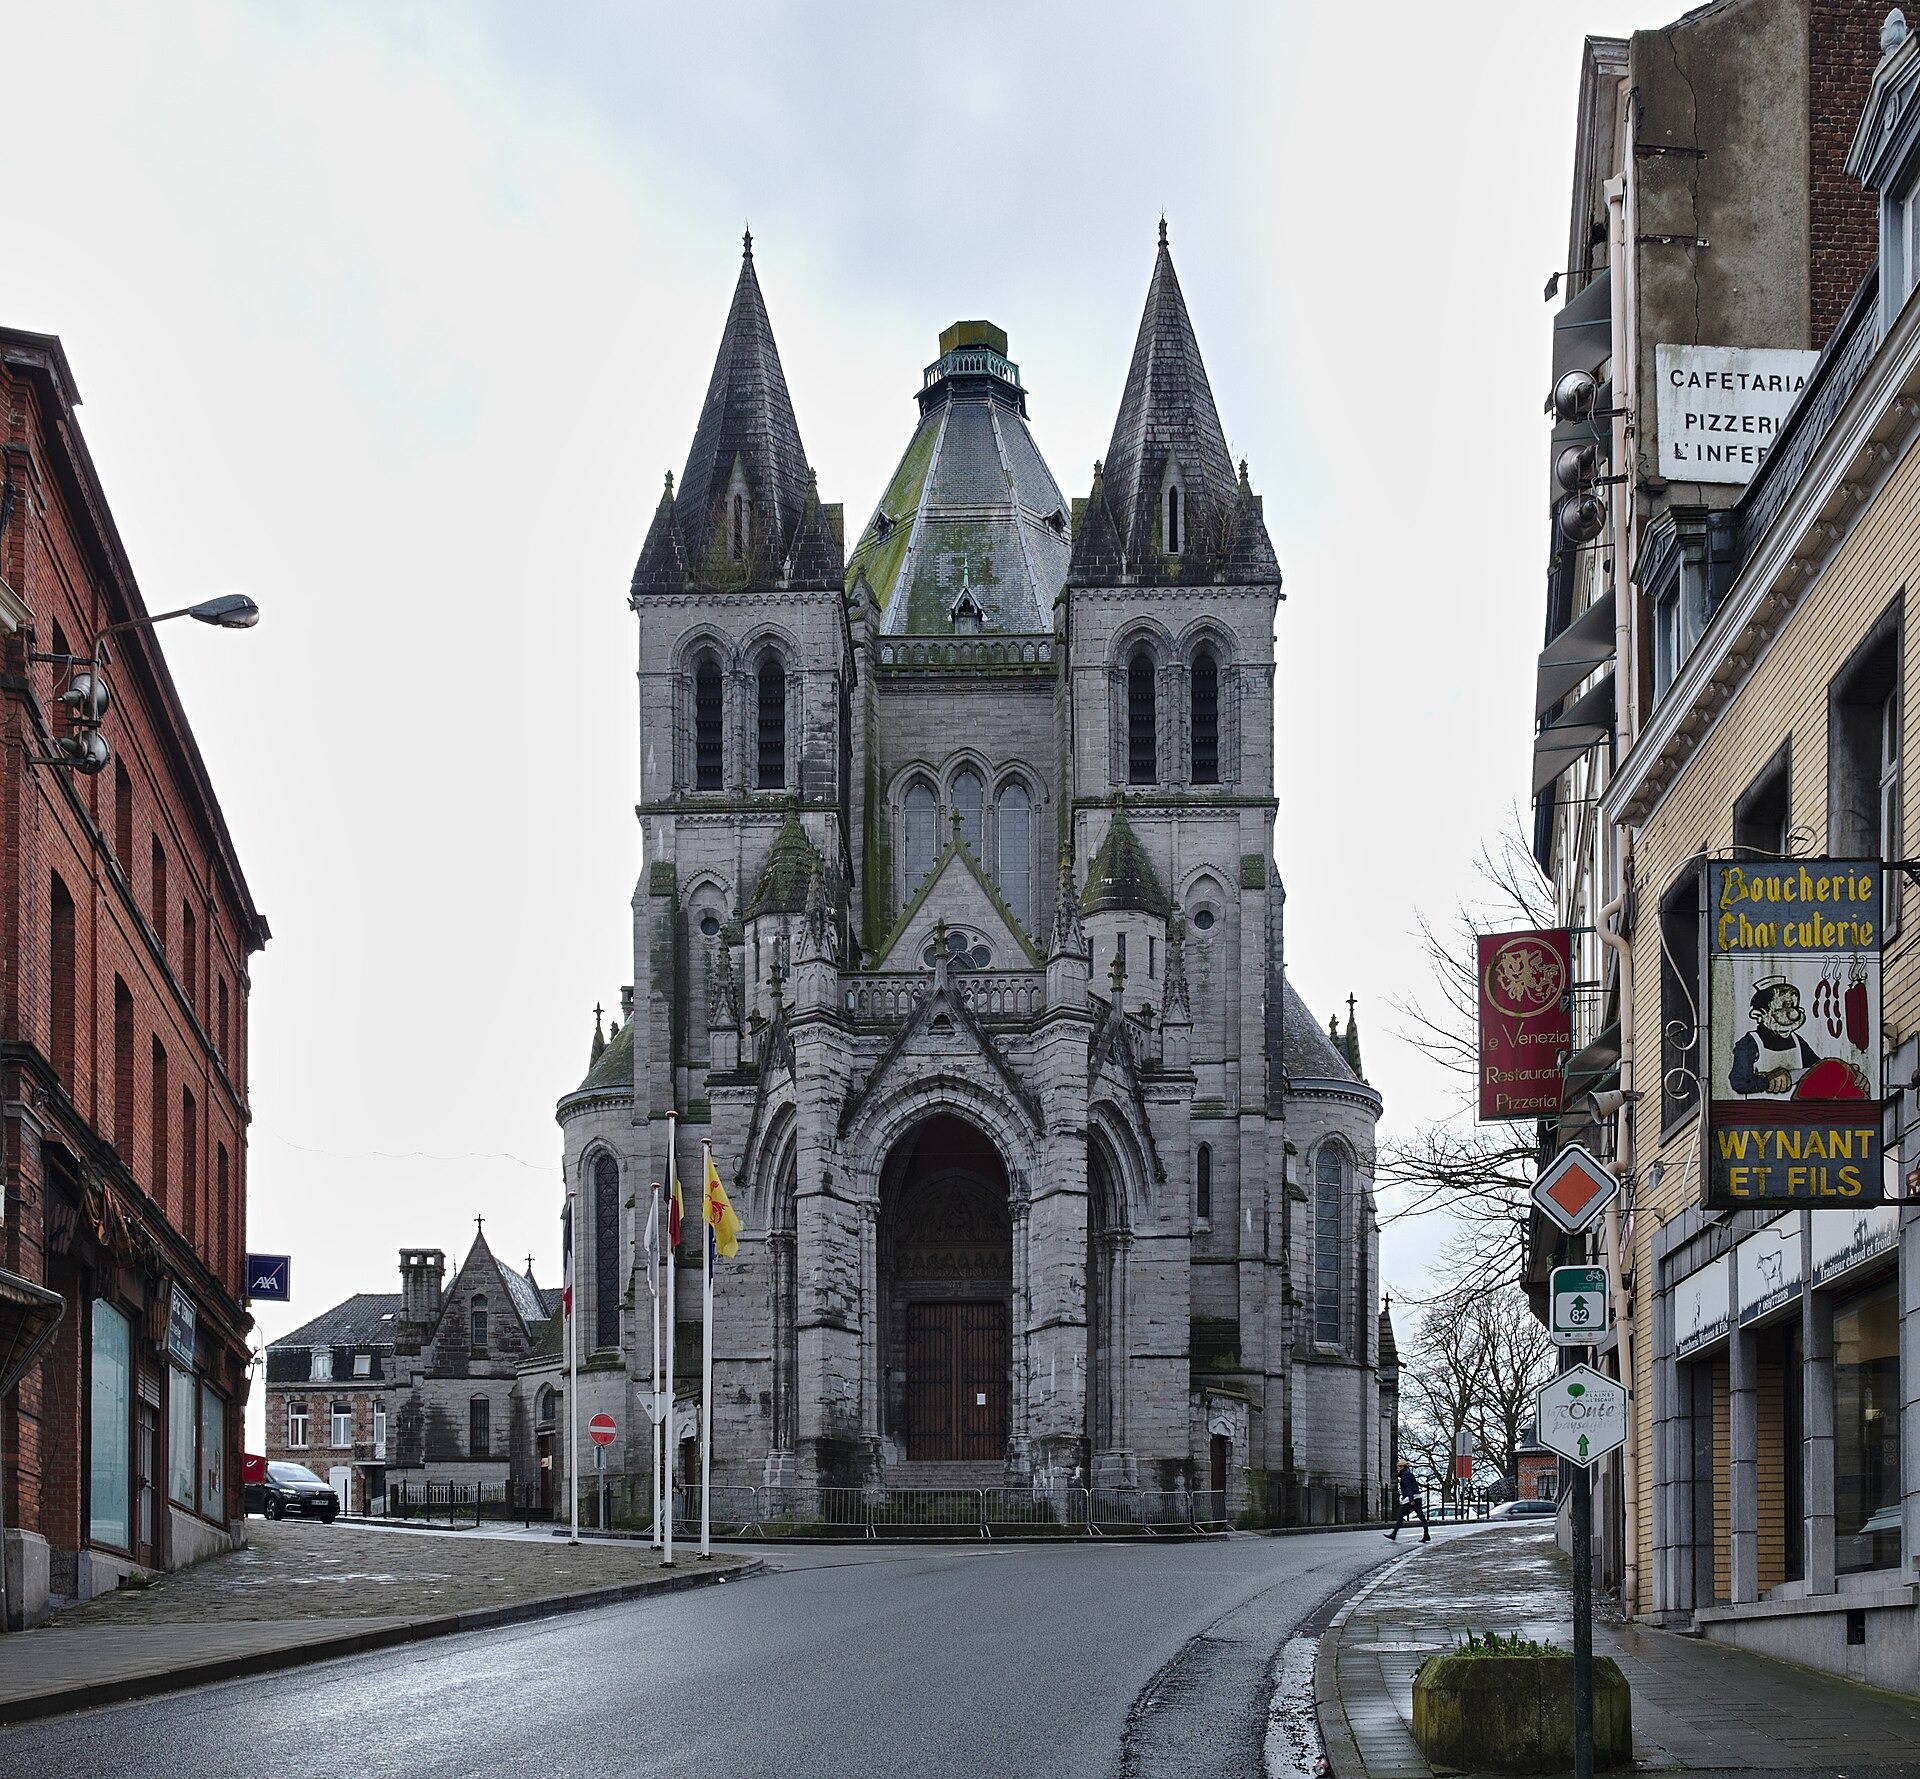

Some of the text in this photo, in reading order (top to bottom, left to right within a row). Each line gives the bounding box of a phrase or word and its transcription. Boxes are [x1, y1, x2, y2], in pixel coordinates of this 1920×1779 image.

[1670, 369, 1805, 393] CAFETARIA
[1719, 865, 1872, 910] Boucherie
[1718, 911, 1874, 951] Charcuterie
[1482, 1021, 1570, 1051] Le Venezia
[1496, 1093, 1557, 1112] Pizzeria
[1717, 1130, 1875, 1160] WYNANT
[1730, 1165, 1862, 1197] ET FILS
[1820, 1231, 1891, 1281] Traiteur chaud et froid
[252, 1276, 279, 1290] AXA
[1572, 1309, 1588, 1322] 82
